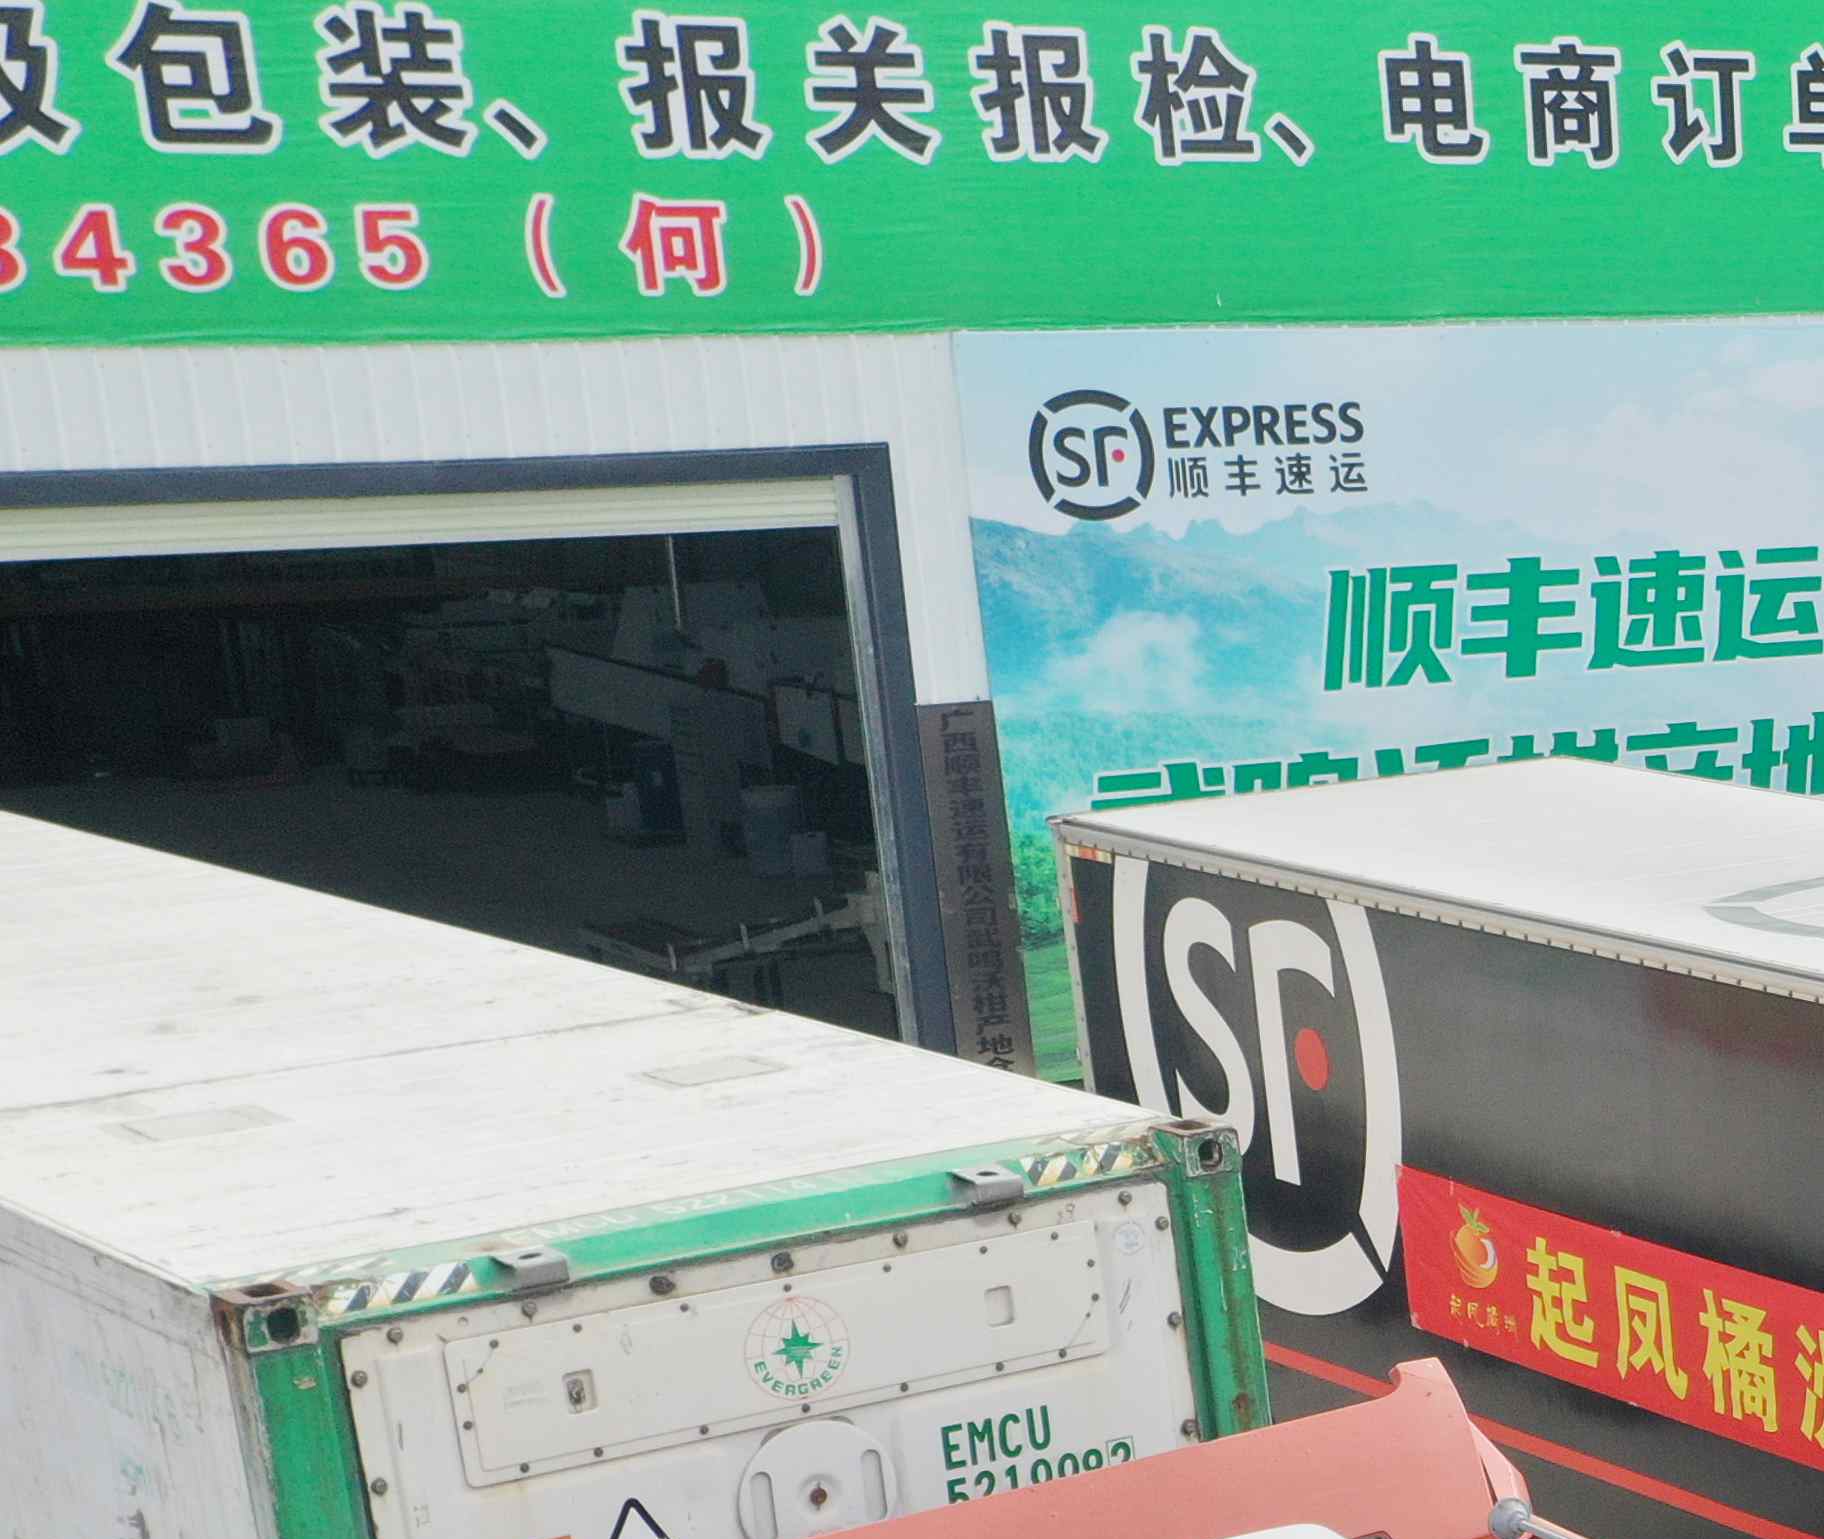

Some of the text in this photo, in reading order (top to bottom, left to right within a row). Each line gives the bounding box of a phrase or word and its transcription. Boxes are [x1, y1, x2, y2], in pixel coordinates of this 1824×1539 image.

[1163, 401, 1366, 448] EXPRESS
[1167, 453, 1369, 499] 顺丰速运
[1324, 545, 1824, 692] 顺丰速运
[753, 1343, 846, 1400] EVERGREEN
[941, 1405, 1051, 1470] EMCU
